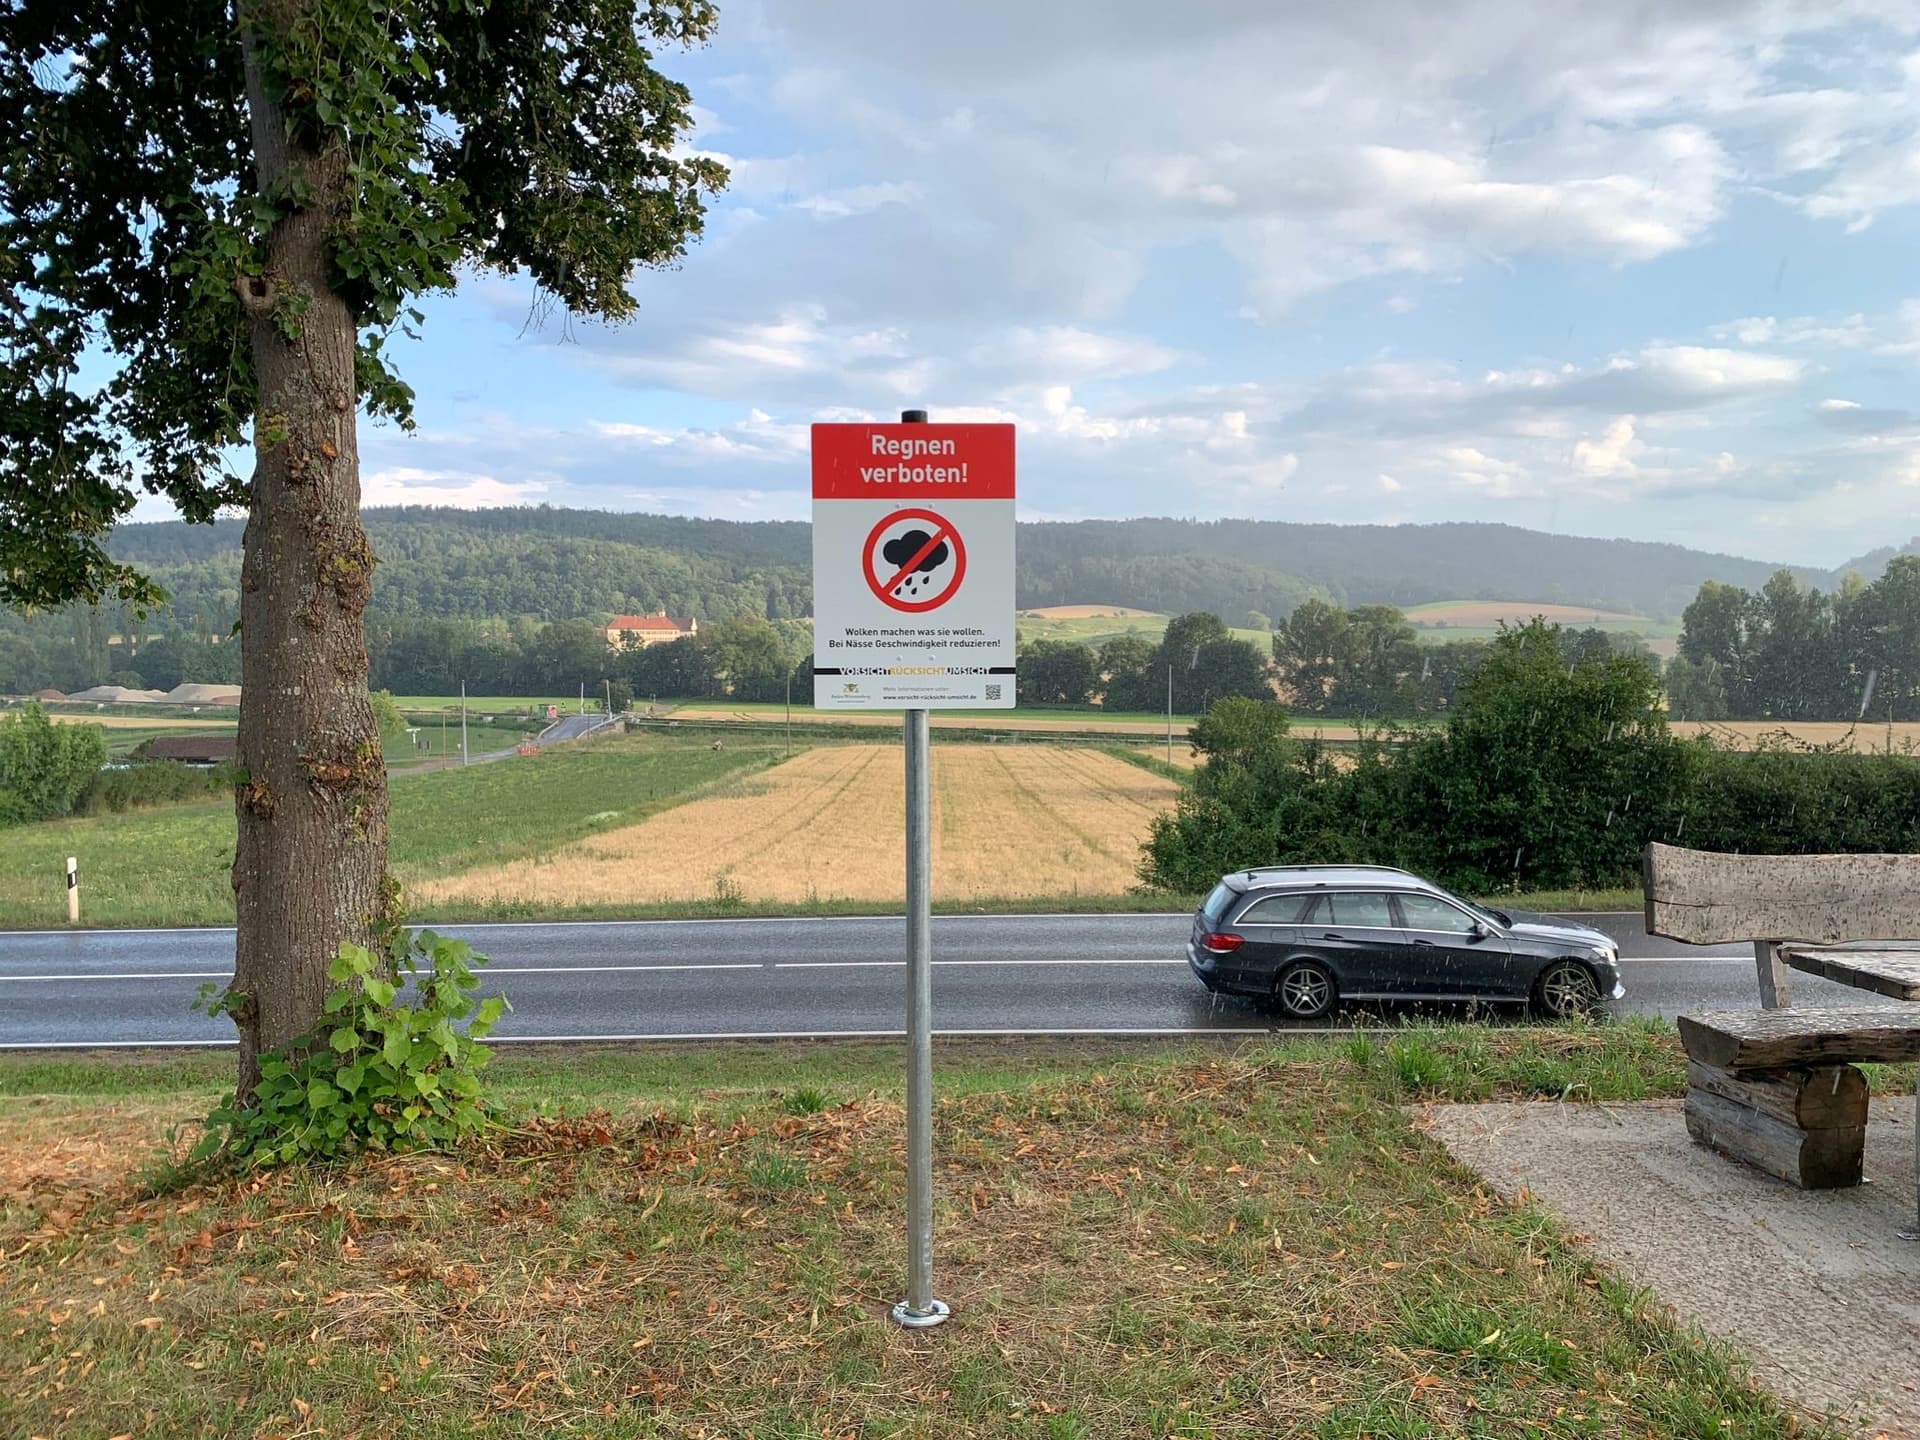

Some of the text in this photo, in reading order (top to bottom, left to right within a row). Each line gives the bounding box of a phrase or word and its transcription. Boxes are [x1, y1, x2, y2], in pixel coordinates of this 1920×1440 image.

[872, 434, 955, 459] Regnen
[860, 463, 968, 483] verboten!
[845, 627, 985, 637] Wolken machen was sie wollen.
[829, 638, 1001, 650] Bei Nässe Geschwindigkeit reduzieren!
